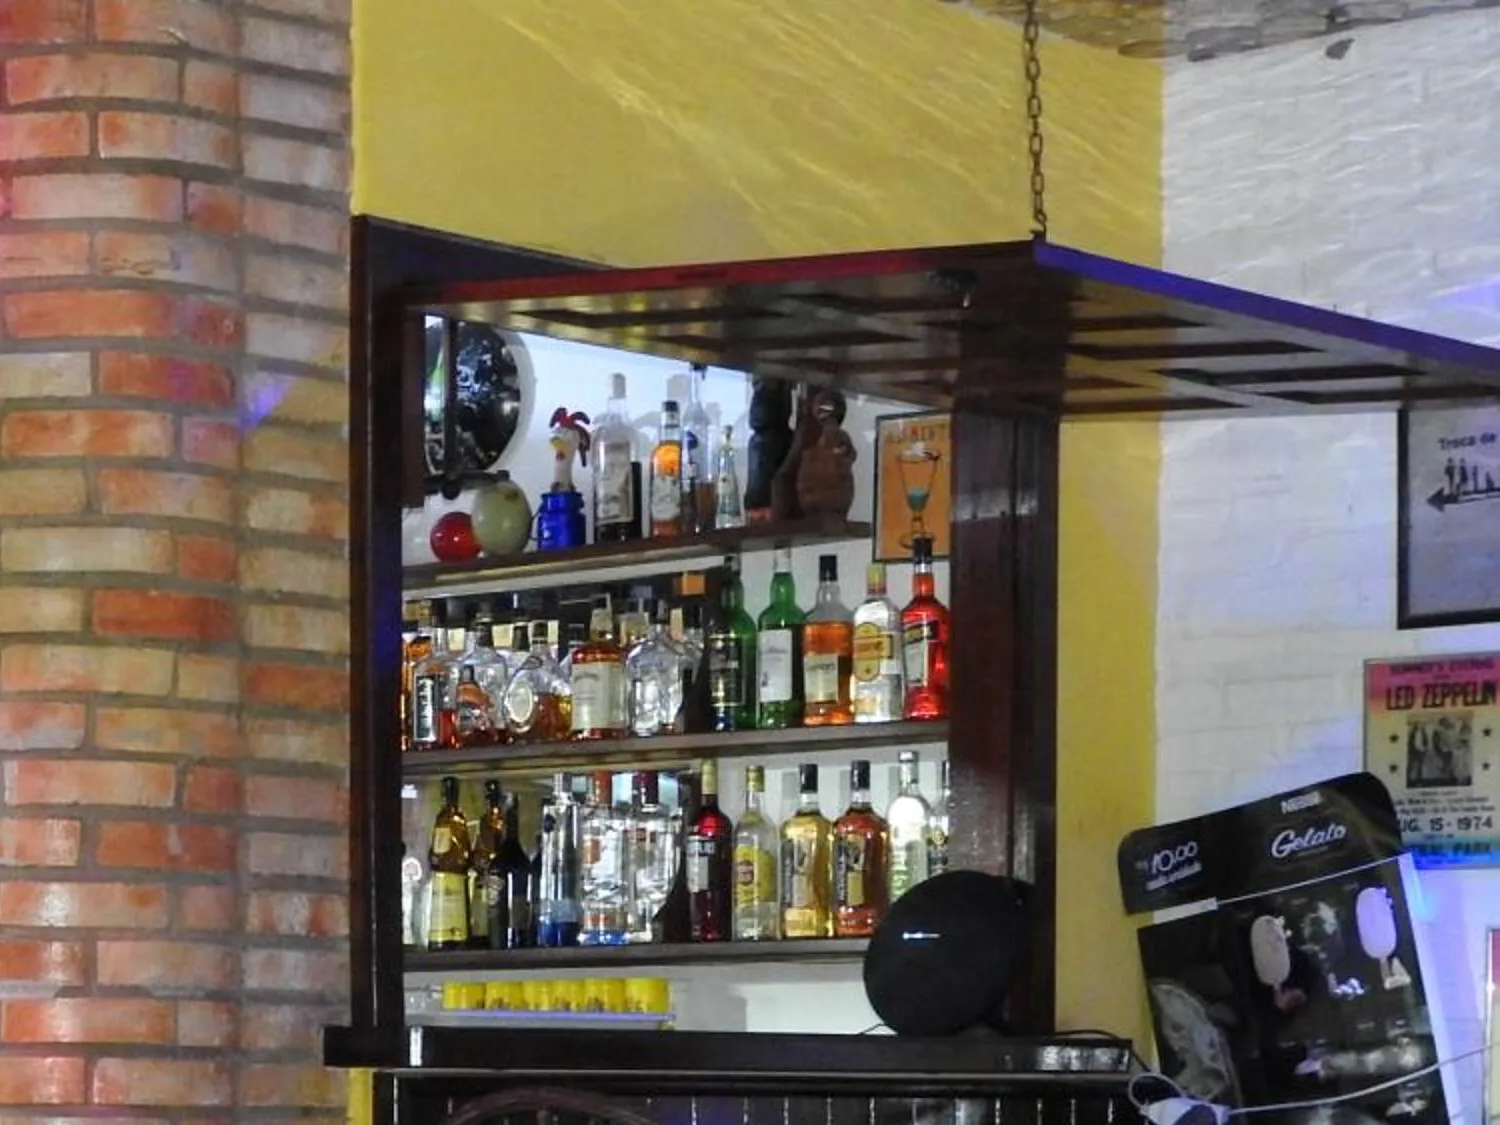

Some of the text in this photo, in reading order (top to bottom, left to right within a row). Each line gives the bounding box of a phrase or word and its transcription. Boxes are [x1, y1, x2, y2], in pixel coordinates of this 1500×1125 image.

[1386, 680, 1497, 710] LED ZEPPELIN
[1457, 815, 1494, 831] 1974
[1270, 821, 1347, 859] Gelato
